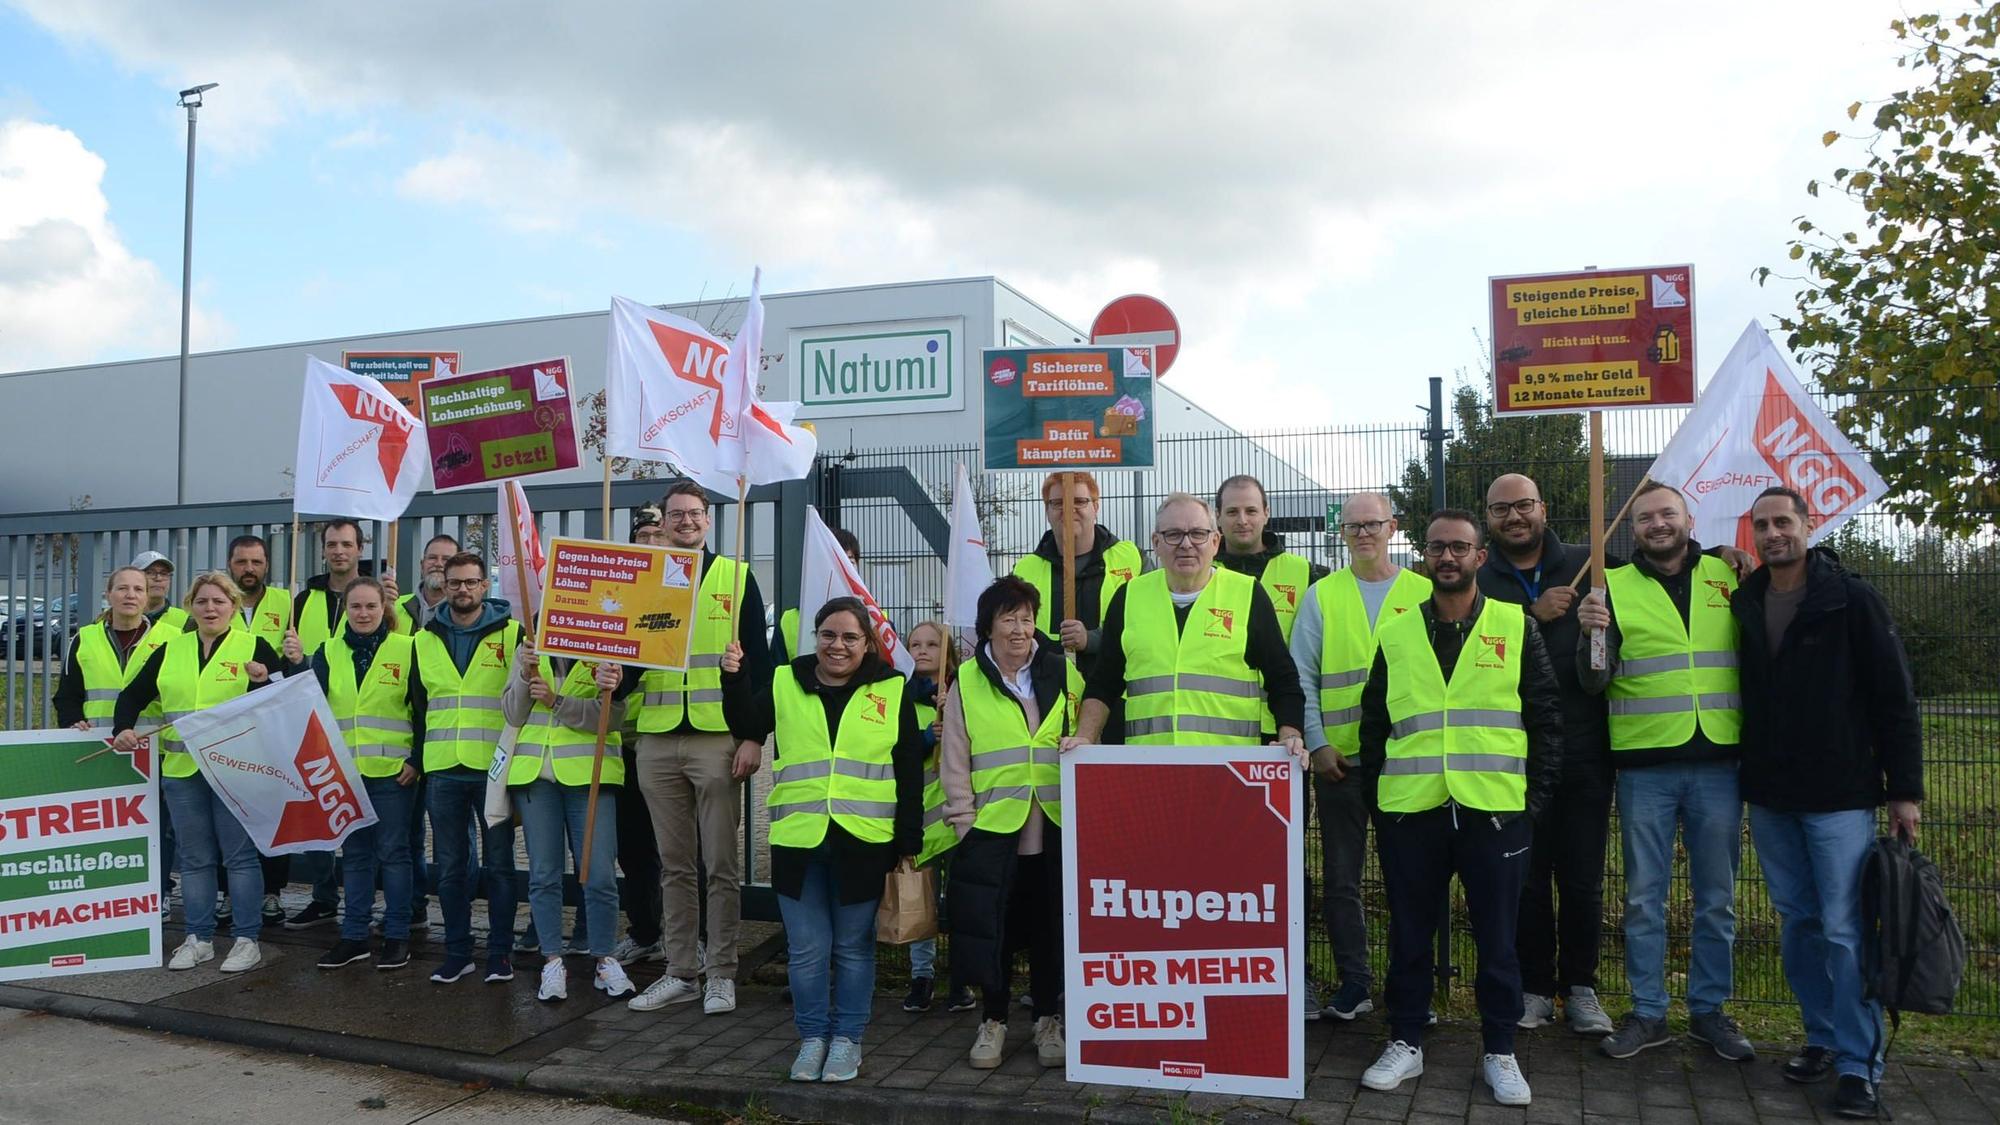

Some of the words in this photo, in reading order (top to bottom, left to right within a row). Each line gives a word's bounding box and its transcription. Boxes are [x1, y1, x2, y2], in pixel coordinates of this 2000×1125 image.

[1666, 273, 1684, 282] NGG
[1513, 287, 1586, 304] Steigende
[1589, 286, 1639, 299] Preise,
[1523, 305, 1577, 322] gleiche
[1581, 303, 1630, 317] Löhne!
[1542, 337, 1578, 348] Nicht
[1580, 336, 1600, 346] mit
[1602, 335, 1630, 345] uns.
[1134, 348, 1150, 357] NGG
[350, 361, 365, 369] Wer
[365, 361, 397, 370] arbeitet,
[398, 361, 412, 369] soll
[546, 366, 563, 375] NGG
[814, 339, 939, 396] Natumi
[1032, 361, 1103, 374] Sicherere
[387, 372, 409, 380] leben
[1525, 373, 1545, 385] 9,9
[1548, 372, 1560, 383] %
[1563, 370, 1598, 382] mehr
[1601, 368, 1633, 381] Geld
[1027, 378, 1109, 392] Tariflöhne.
[1514, 391, 1529, 402] 12
[1533, 389, 1584, 401] Monate
[1587, 385, 1645, 399] Laufzeit
[430, 385, 505, 406] Nachhaltige
[432, 399, 526, 422] Lohnerhöhung.
[1049, 429, 1089, 441] Dafür
[491, 445, 549, 469] Jetzt!
[1022, 447, 1086, 462] kämpfen
[1089, 446, 1116, 459] wir.
[1762, 416, 1856, 516] NGG
[558, 550, 590, 564] Gegen
[591, 554, 615, 565] hohe
[616, 557, 648, 568] Preise
[676, 556, 692, 565] NGG
[557, 563, 589, 575] helfen
[590, 569, 608, 578] nur
[609, 569, 634, 580] hohe
[555, 577, 588, 589] Löhne.
[555, 594, 589, 606] Darum:
[642, 612, 672, 621] MEHR
[1214, 609, 1233, 618] NGG
[550, 615, 566, 625] 9,9
[566, 616, 574, 625] %
[575, 619, 601, 629] mehr
[601, 620, 624, 632] Geld
[648, 619, 681, 630] UNS!
[547, 636, 558, 646] 12
[559, 637, 595, 650] Monate
[596, 641, 637, 655] Laufzeit
[1486, 637, 1505, 645] NGG
[870, 693, 886, 705] NGG
[208, 751, 309, 798] GEWERKSCHAFT
[1249, 763, 1290, 781] NGG
[303, 755, 357, 835] NGG
[0, 852, 144, 877] nschließen
[48, 875, 85, 891] und
[1089, 878, 1276, 929] Hupen!
[0, 893, 158, 935] ITMACHEN!
[1082, 953, 1157, 987] FÜR
[1166, 956, 1277, 986] MEHR
[1086, 1001, 1196, 1030] GELD!
